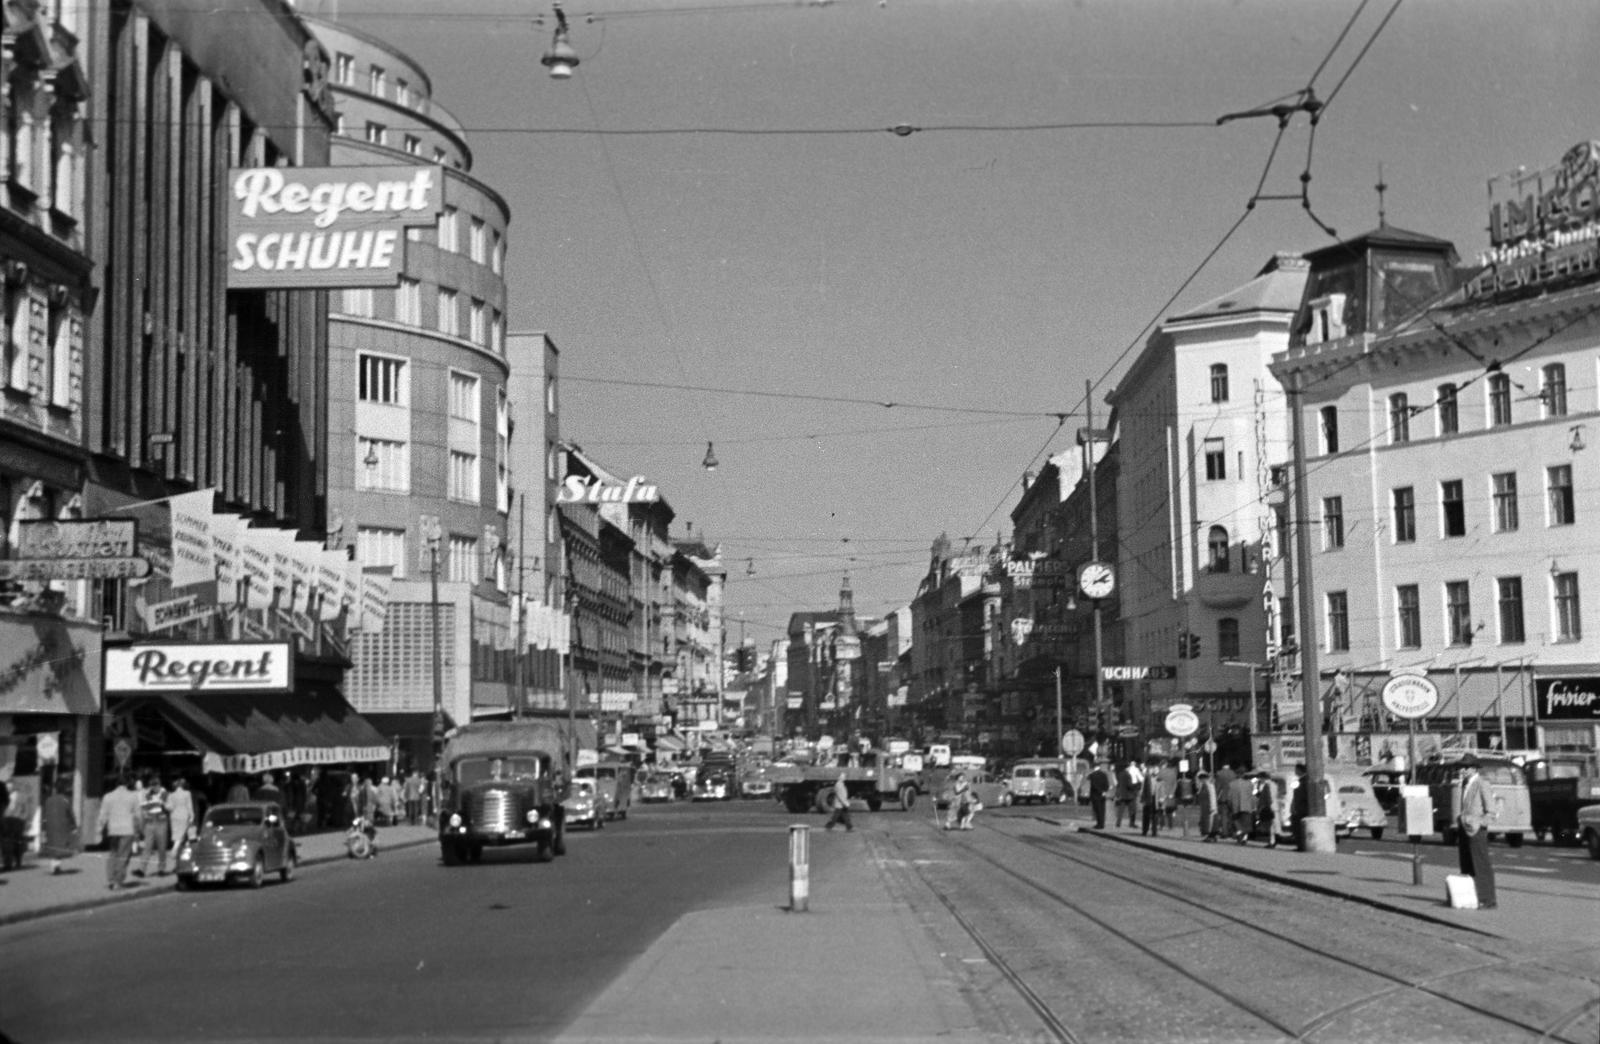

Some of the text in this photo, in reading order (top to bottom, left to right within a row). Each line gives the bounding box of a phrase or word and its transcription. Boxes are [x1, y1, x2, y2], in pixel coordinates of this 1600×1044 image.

[234, 168, 433, 228] Regent
[232, 229, 398, 271] SCHUHE
[133, 649, 273, 688] Regent
